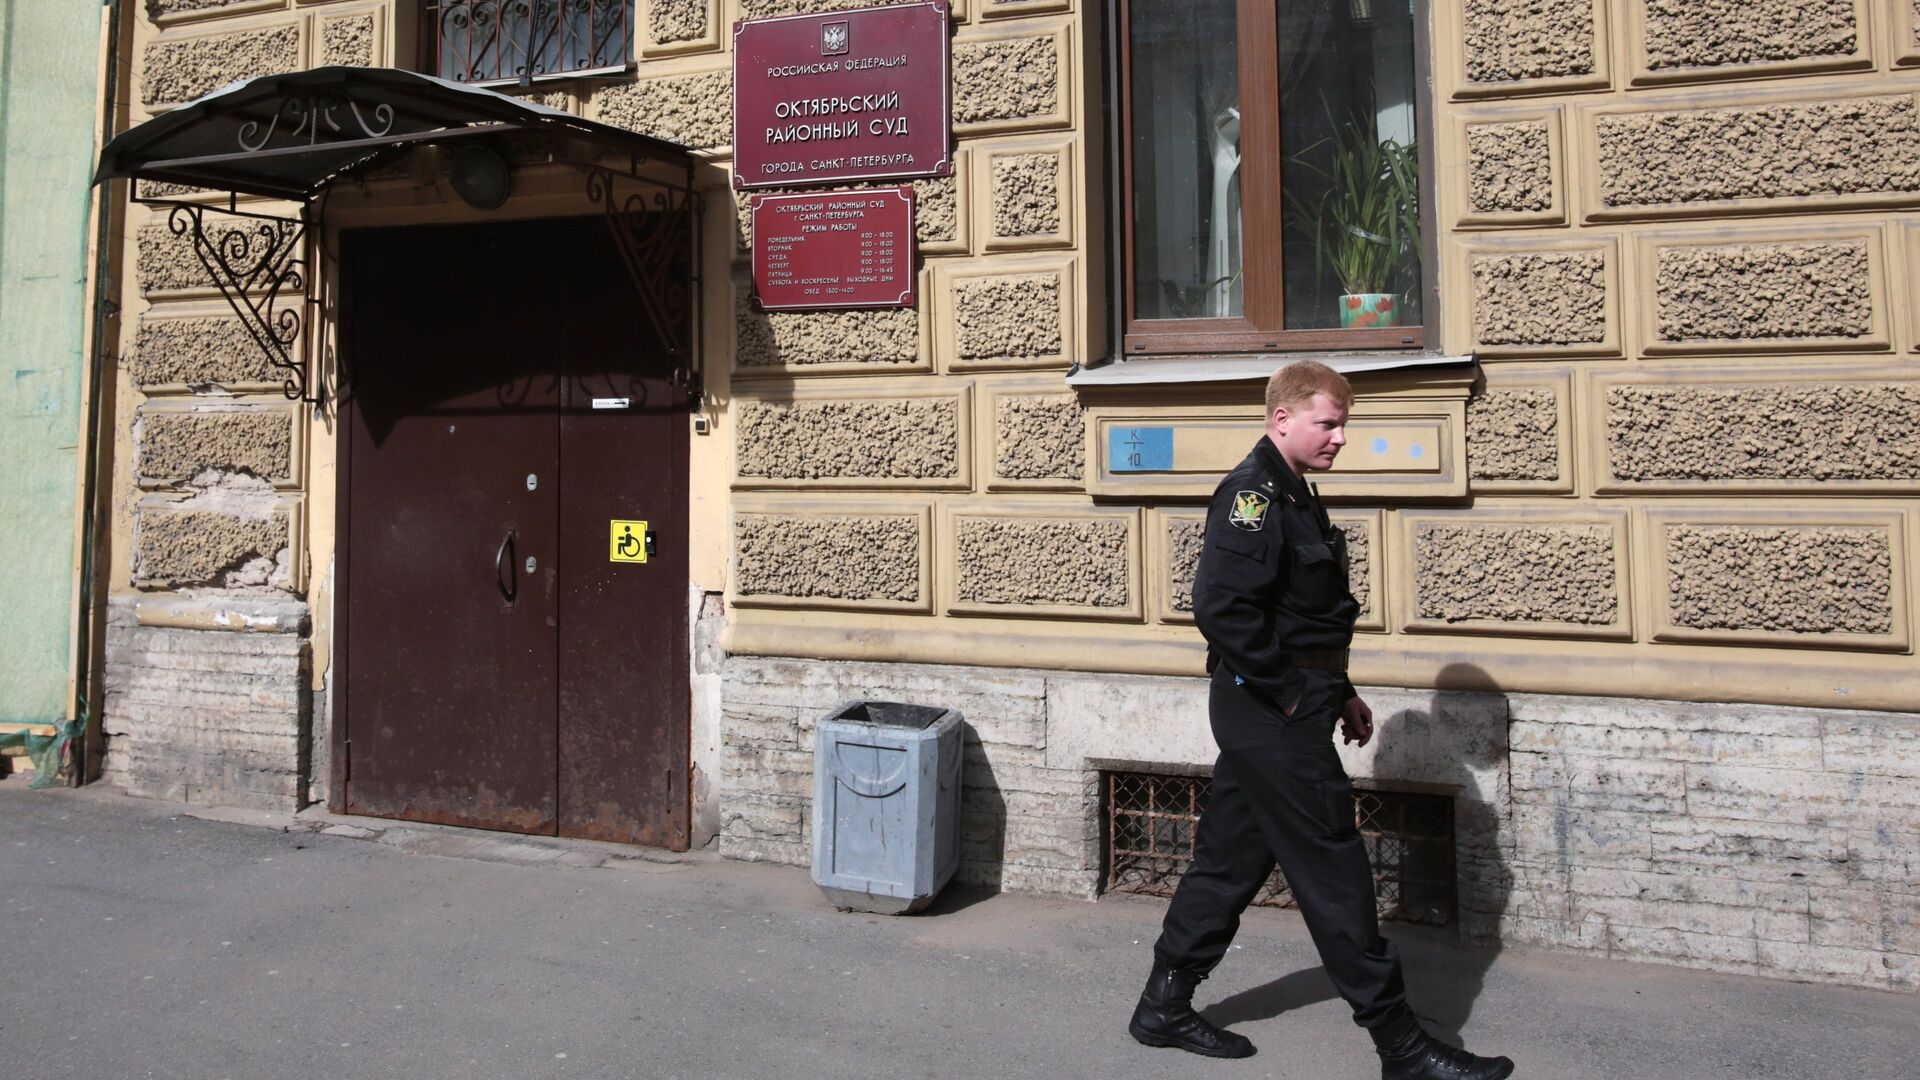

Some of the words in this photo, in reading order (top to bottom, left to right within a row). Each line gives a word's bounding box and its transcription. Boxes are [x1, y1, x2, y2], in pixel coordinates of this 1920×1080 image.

[767, 61, 839, 78] РОССИЙСКАЯ
[844, 54, 907, 71] ФЕДЕРАЦИЯ
[775, 90, 899, 118] ОКТЯБРЬСКИЙ
[766, 119, 858, 144] РАЙОННЫЙ
[869, 117, 909, 136] СУД
[761, 161, 804, 174] ГОРОДА
[810, 153, 914, 171] САНКТ-ПЕТЕРБУРГА
[775, 203, 824, 213] ОКТЯБРЬСКИЙ
[828, 200, 866, 210] РАЙОННЫЙ
[869, 200, 885, 208] СУД
[801, 224, 827, 233] РЕЖИМ
[830, 223, 857, 231] РАБОТЫ
[767, 235, 806, 243] ПОНЕДЕЛЬНИК
[846, 275, 878, 283] ВЫХОДНЫЕ
